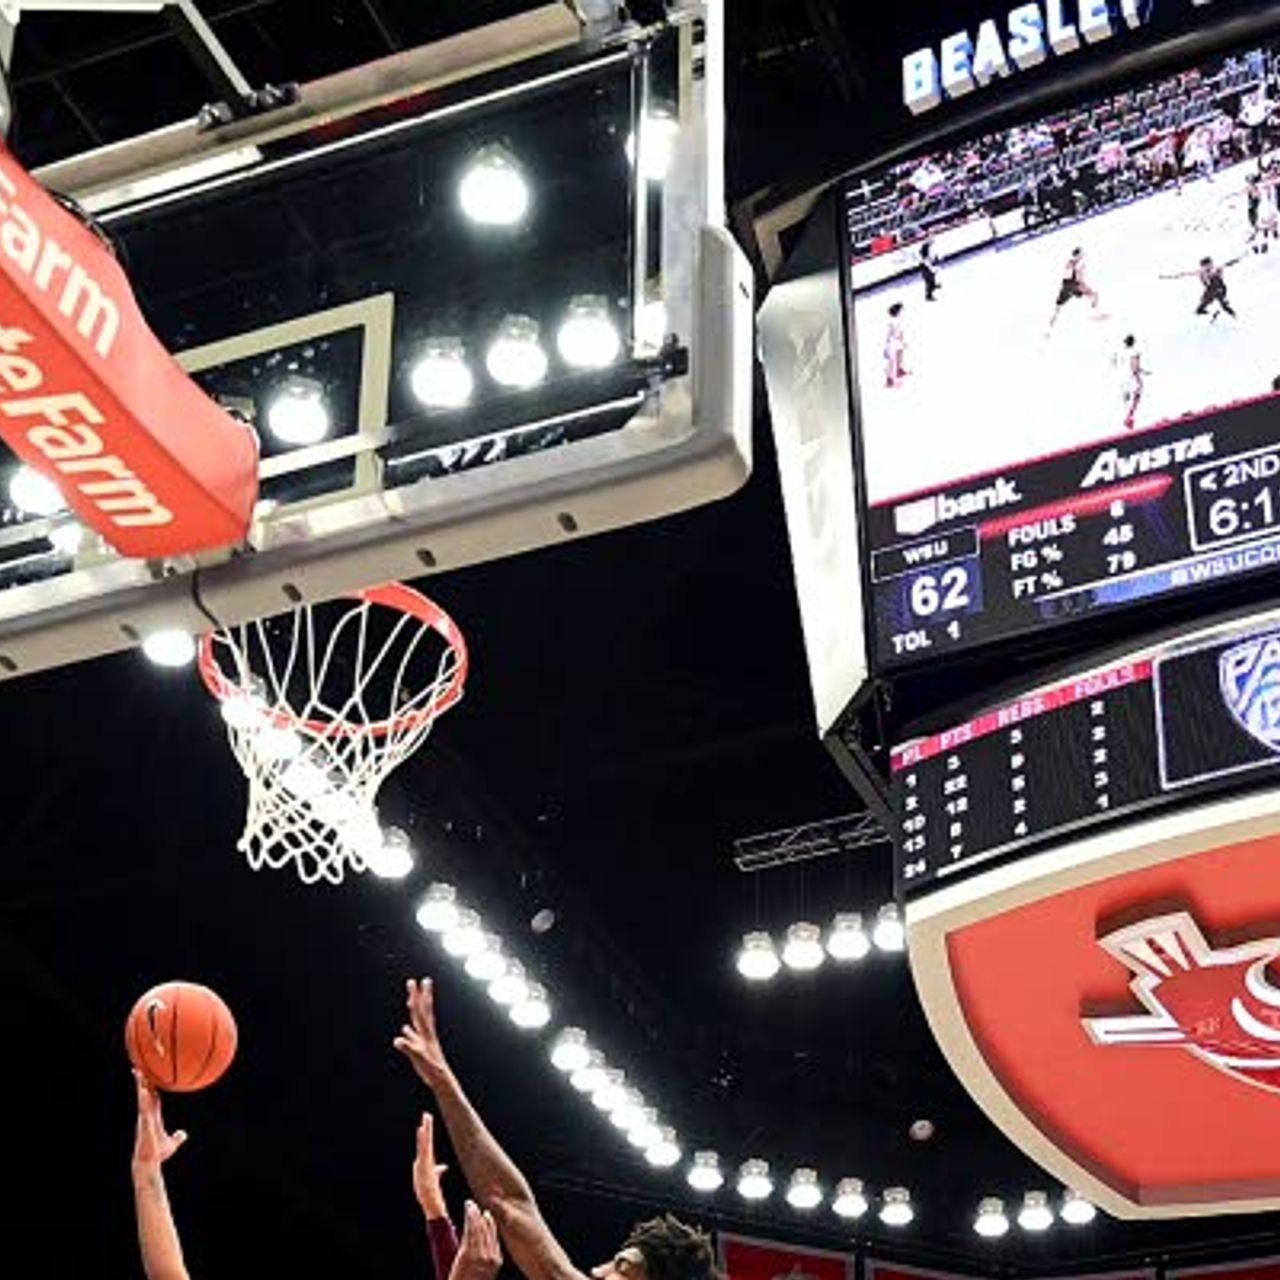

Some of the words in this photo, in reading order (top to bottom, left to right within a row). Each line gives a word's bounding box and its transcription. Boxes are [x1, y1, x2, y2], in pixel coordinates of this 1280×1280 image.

[1223, 455, 1280, 487] 2ND
[1008, 514, 1076, 547] FOULS
[903, 540, 948, 565] WSU
[1011, 550, 1038, 571] FG
[1040, 544, 1063, 563] %
[911, 567, 969, 616] 62
[1013, 575, 1037, 600] FT
[1040, 570, 1063, 590] %
[891, 629, 932, 654] TOL
[947, 620, 961, 640] 1
